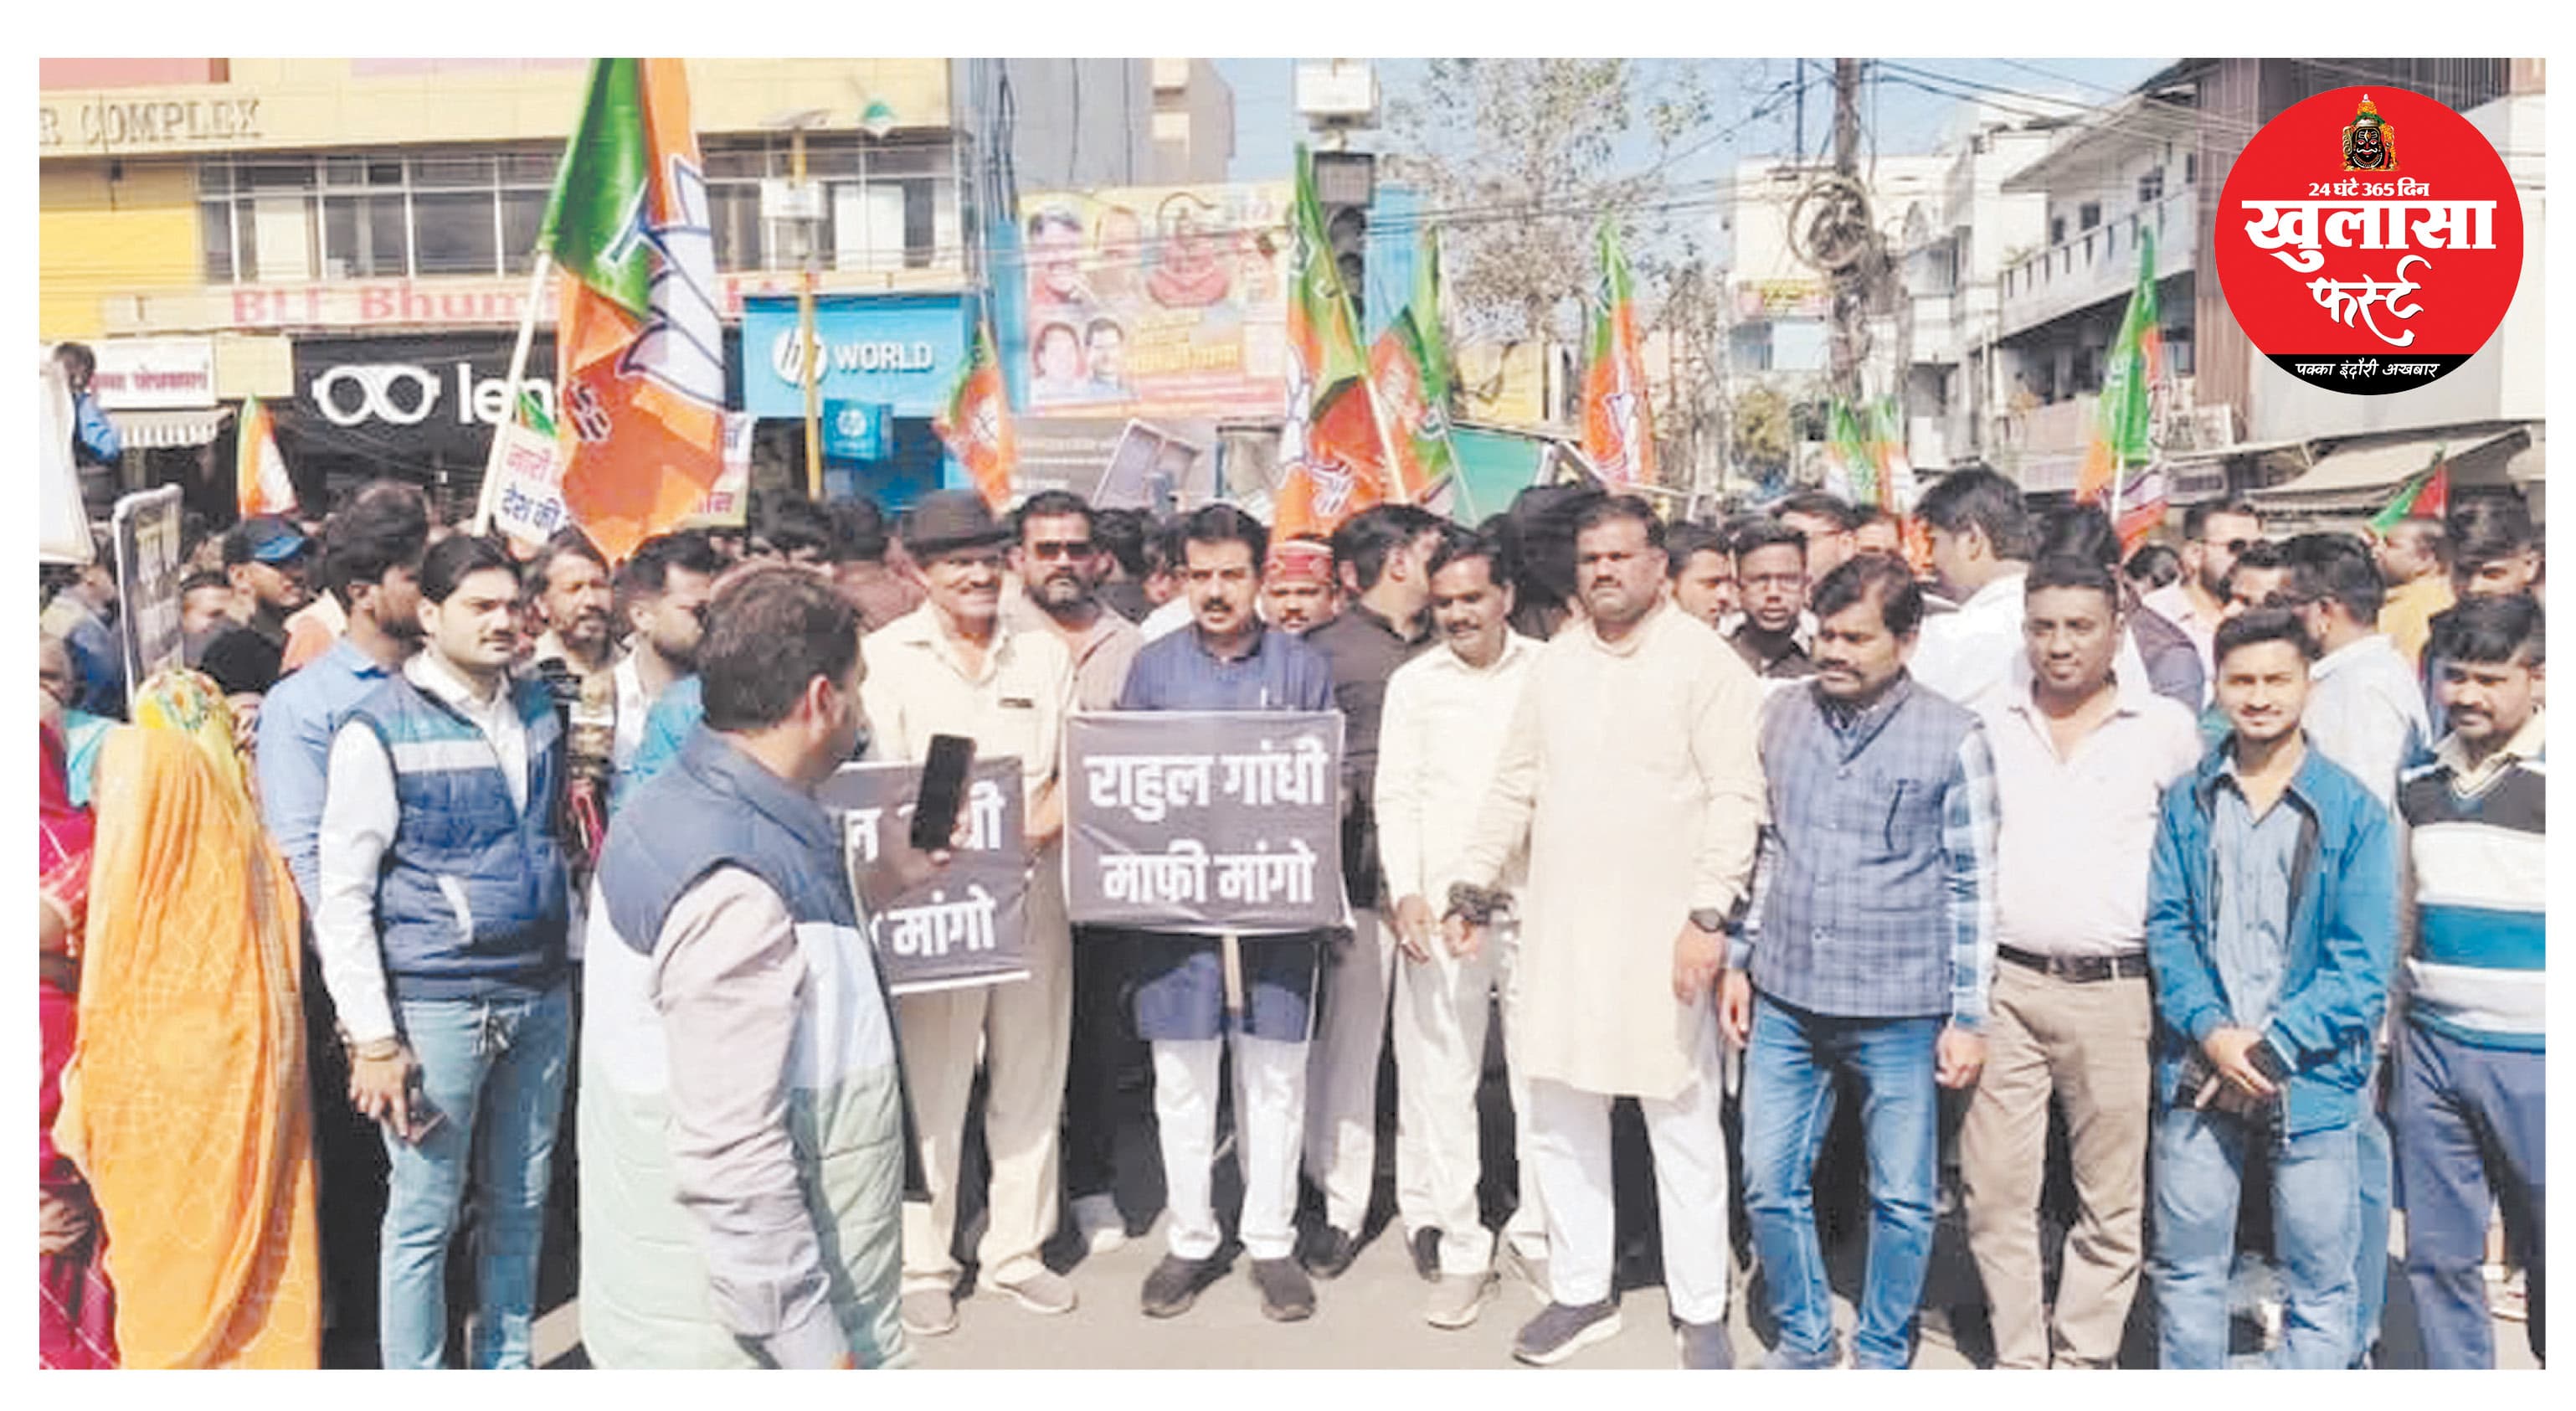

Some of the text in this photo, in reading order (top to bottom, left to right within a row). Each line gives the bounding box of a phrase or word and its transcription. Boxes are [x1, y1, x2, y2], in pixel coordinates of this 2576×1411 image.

[81, 98, 263, 146] COMPLEX
[835, 341, 933, 373] WORLD
[1082, 753, 1214, 823] राहुल
[1220, 734, 1329, 807] गांधी
[1098, 837, 1318, 904] माफी मांगो
[886, 883, 997, 958] मांगो
